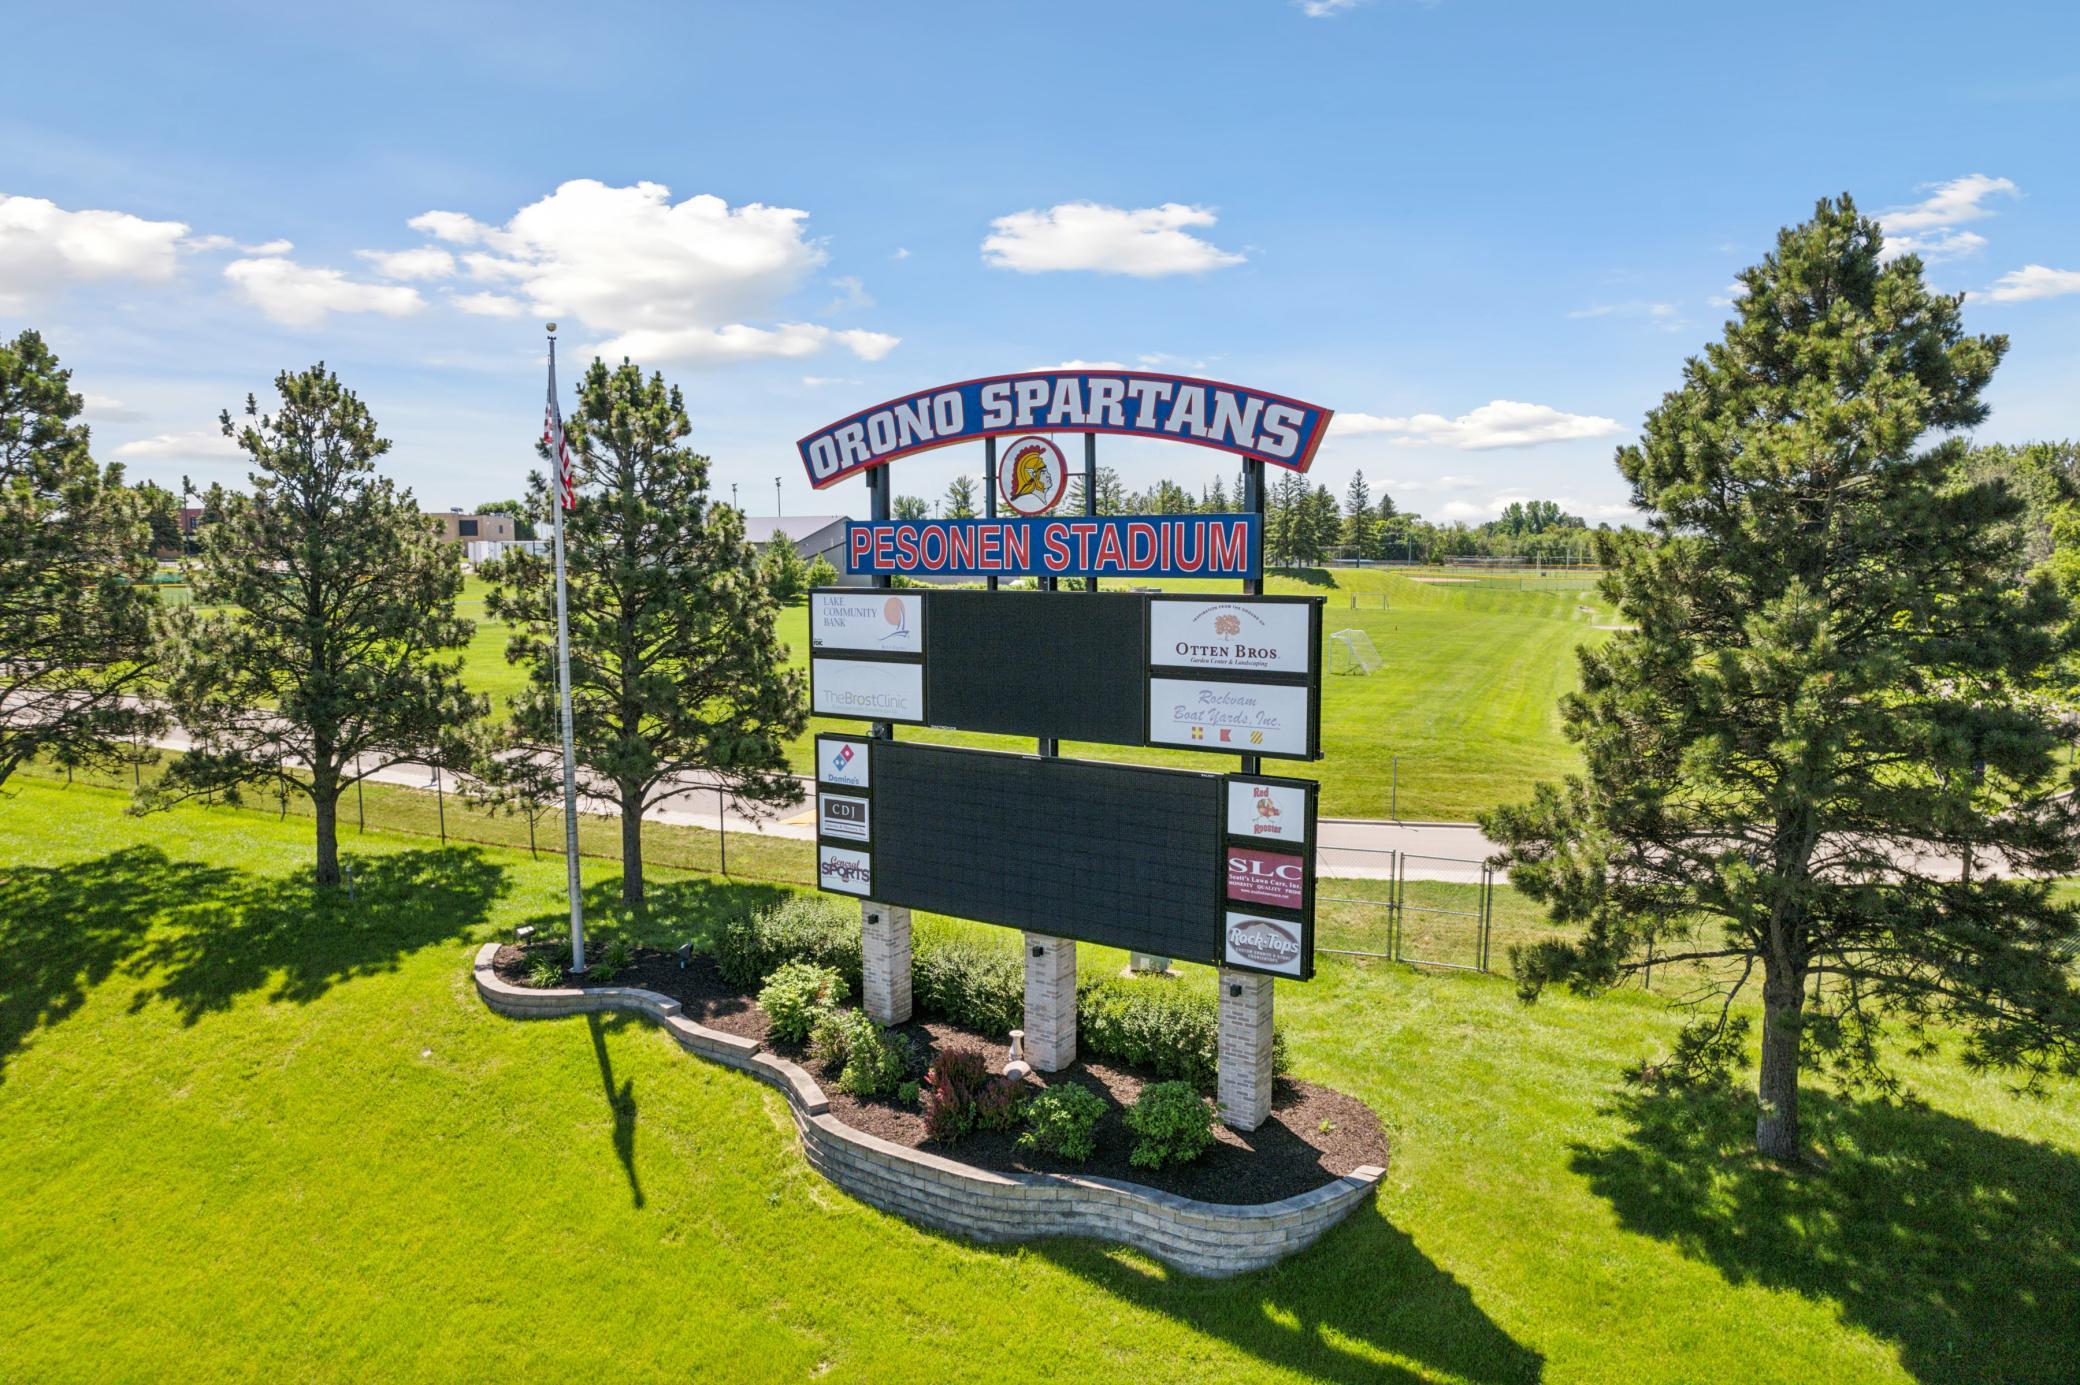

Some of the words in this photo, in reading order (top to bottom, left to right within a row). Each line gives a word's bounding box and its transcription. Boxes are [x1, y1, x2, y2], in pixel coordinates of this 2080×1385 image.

[809, 390, 964, 480] ORONO
[981, 377, 1306, 458] SPARTANS
[851, 524, 1031, 571] PESONEN
[1043, 521, 1248, 572] STADIUM
[823, 597, 845, 606] LAKE
[823, 608, 877, 617] COMMUNITY
[823, 618, 846, 627] BANK
[1175, 642, 1230, 657] OTTEN
[823, 690, 908, 710] TheBrostClinic
[1198, 689, 1257, 706] Rockvam
[1173, 705, 1203, 721] Boat
[1255, 710, 1281, 727] Inc.
[828, 774, 860, 785] Domino's
[1253, 787, 1270, 798] Red
[1253, 824, 1283, 834] Rooster
[830, 855, 860, 870] General
[1228, 857, 1303, 881] SLC
[821, 861, 870, 883] SPORTS
[1251, 876, 1270, 885] Lawn
